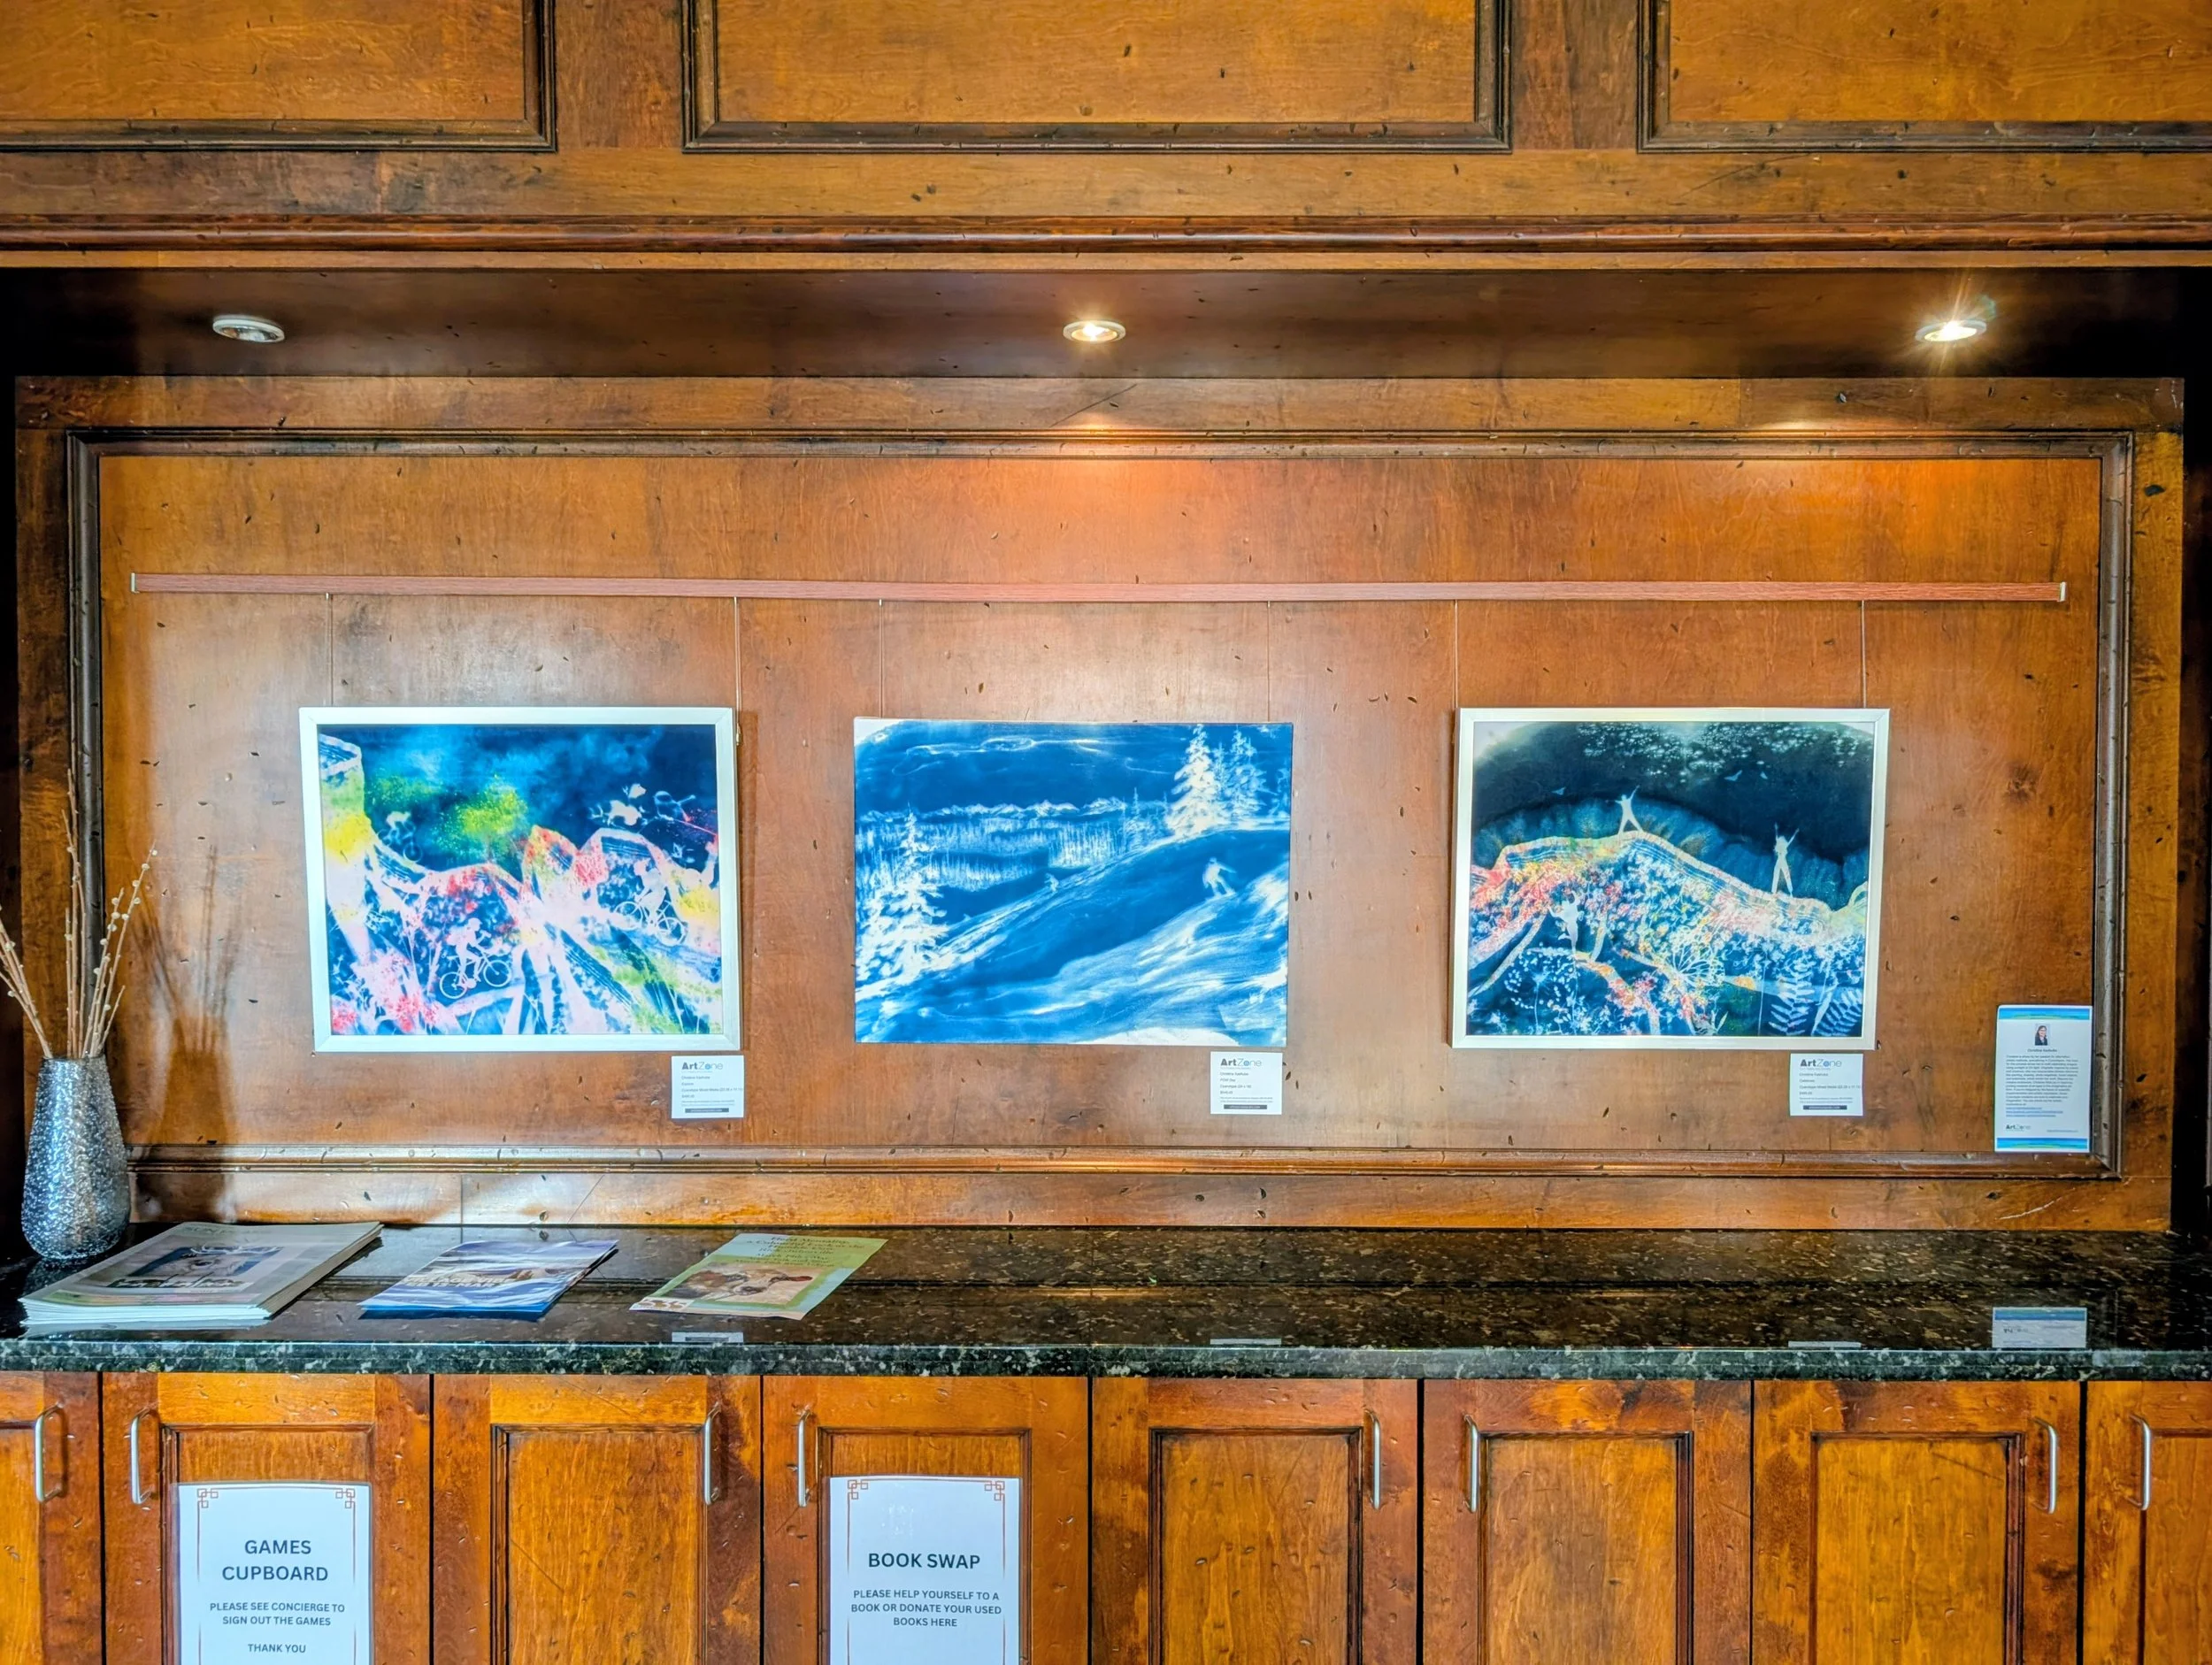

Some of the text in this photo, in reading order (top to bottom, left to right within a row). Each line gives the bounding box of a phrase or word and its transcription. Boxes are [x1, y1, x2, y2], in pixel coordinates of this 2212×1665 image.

[244, 1540, 311, 1554] GAMES
[868, 1554, 980, 1569] BOOK SWAP
[222, 1566, 328, 1581] CUPBOARD
[853, 1590, 891, 1599] PLEASE
[894, 1590, 920, 1599] HELP
[922, 1591, 974, 1600] YOURSELF
[210, 1602, 248, 1611] PLEASE
[271, 1603, 329, 1612] CONCIERGE
[332, 1604, 345, 1613] TO
[900, 1604, 941, 1613] DONATE
[943, 1605, 972, 1614] YOUR
[974, 1606, 1002, 1615] USED
[223, 1616, 248, 1625] SIGN
[250, 1616, 271, 1625] OUT
[296, 1617, 331, 1626] GAMES
[931, 1618, 957, 1627] HERE
[248, 1644, 282, 1653] THANK
